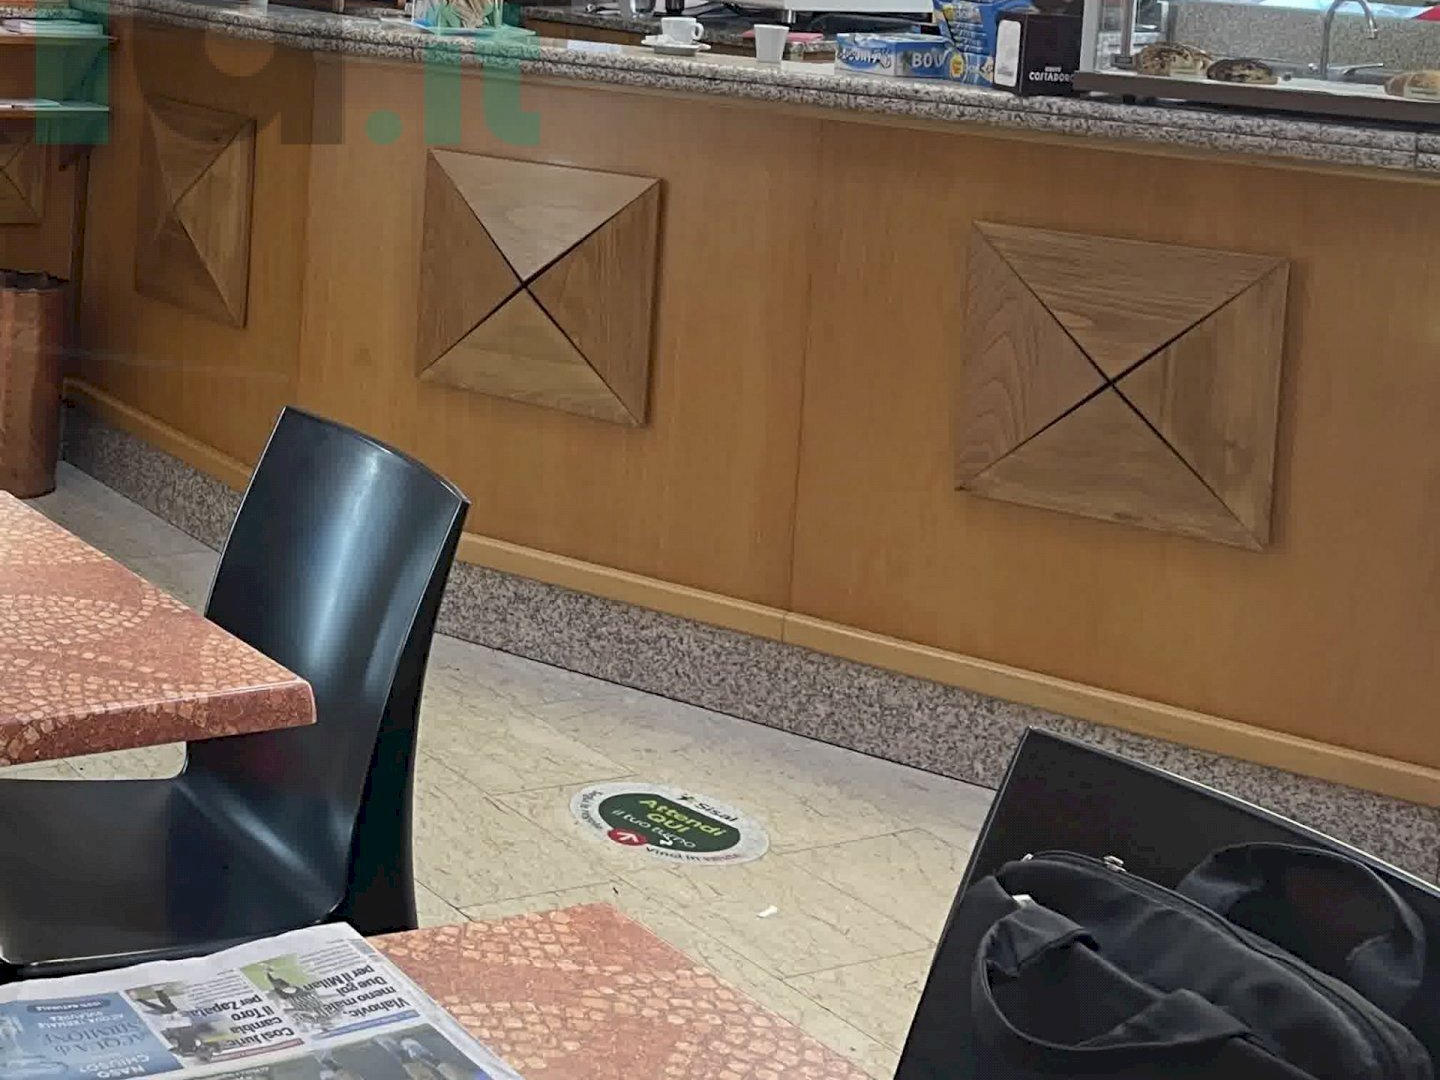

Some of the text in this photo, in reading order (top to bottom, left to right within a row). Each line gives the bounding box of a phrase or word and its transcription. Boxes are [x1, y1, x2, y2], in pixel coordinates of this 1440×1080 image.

[639, 798, 727, 837] Attendi
[696, 801, 738, 823] Sisal
[623, 814, 652, 828] tuo
[651, 826, 697, 849] turno
[646, 813, 693, 834] QUI
[96, 1064, 145, 1079] NASO
